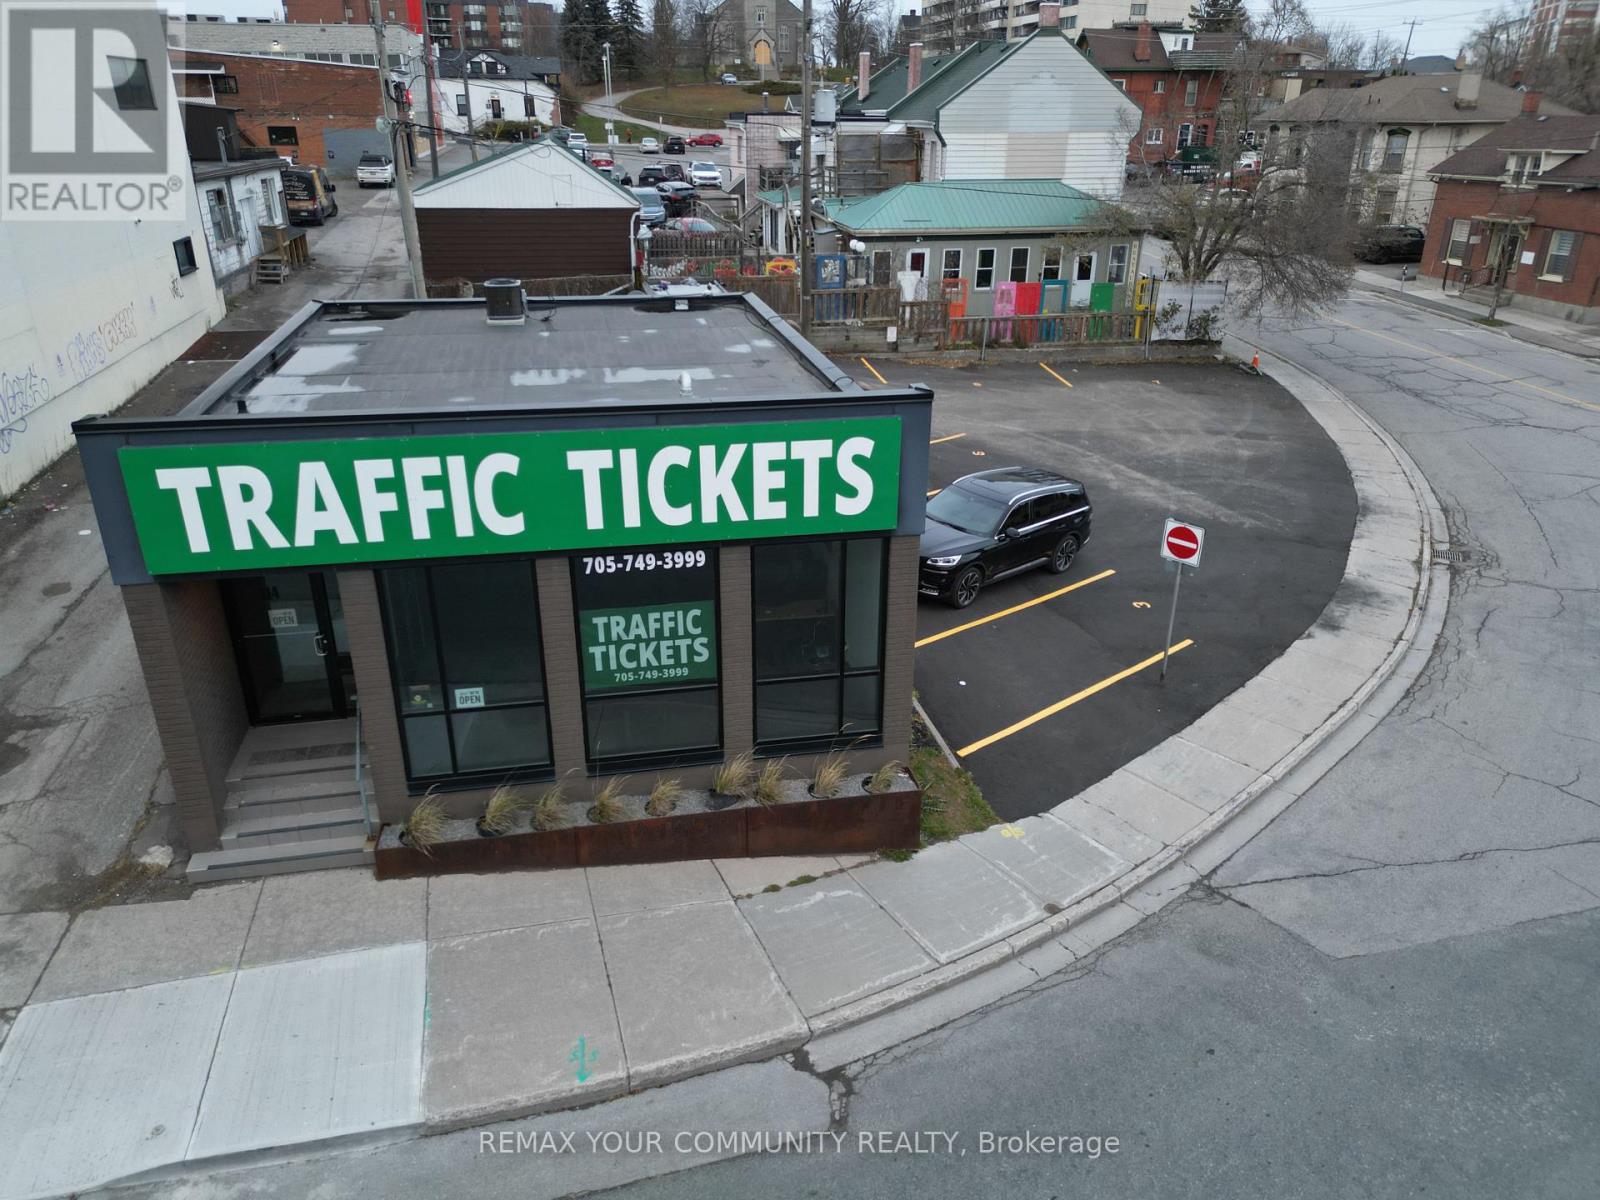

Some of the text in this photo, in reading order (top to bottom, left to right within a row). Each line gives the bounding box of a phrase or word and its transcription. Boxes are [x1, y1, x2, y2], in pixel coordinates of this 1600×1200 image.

[155, 436, 876, 553] TRAFFIC TICKETS
[583, 550, 706, 574] 705-749-3999
[272, 615, 295, 626] OPEN
[592, 609, 702, 642] TRAFFIC
[589, 637, 710, 671] TICKETS
[614, 667, 689, 682] 705-749-3999
[459, 694, 481, 705] OPEN
